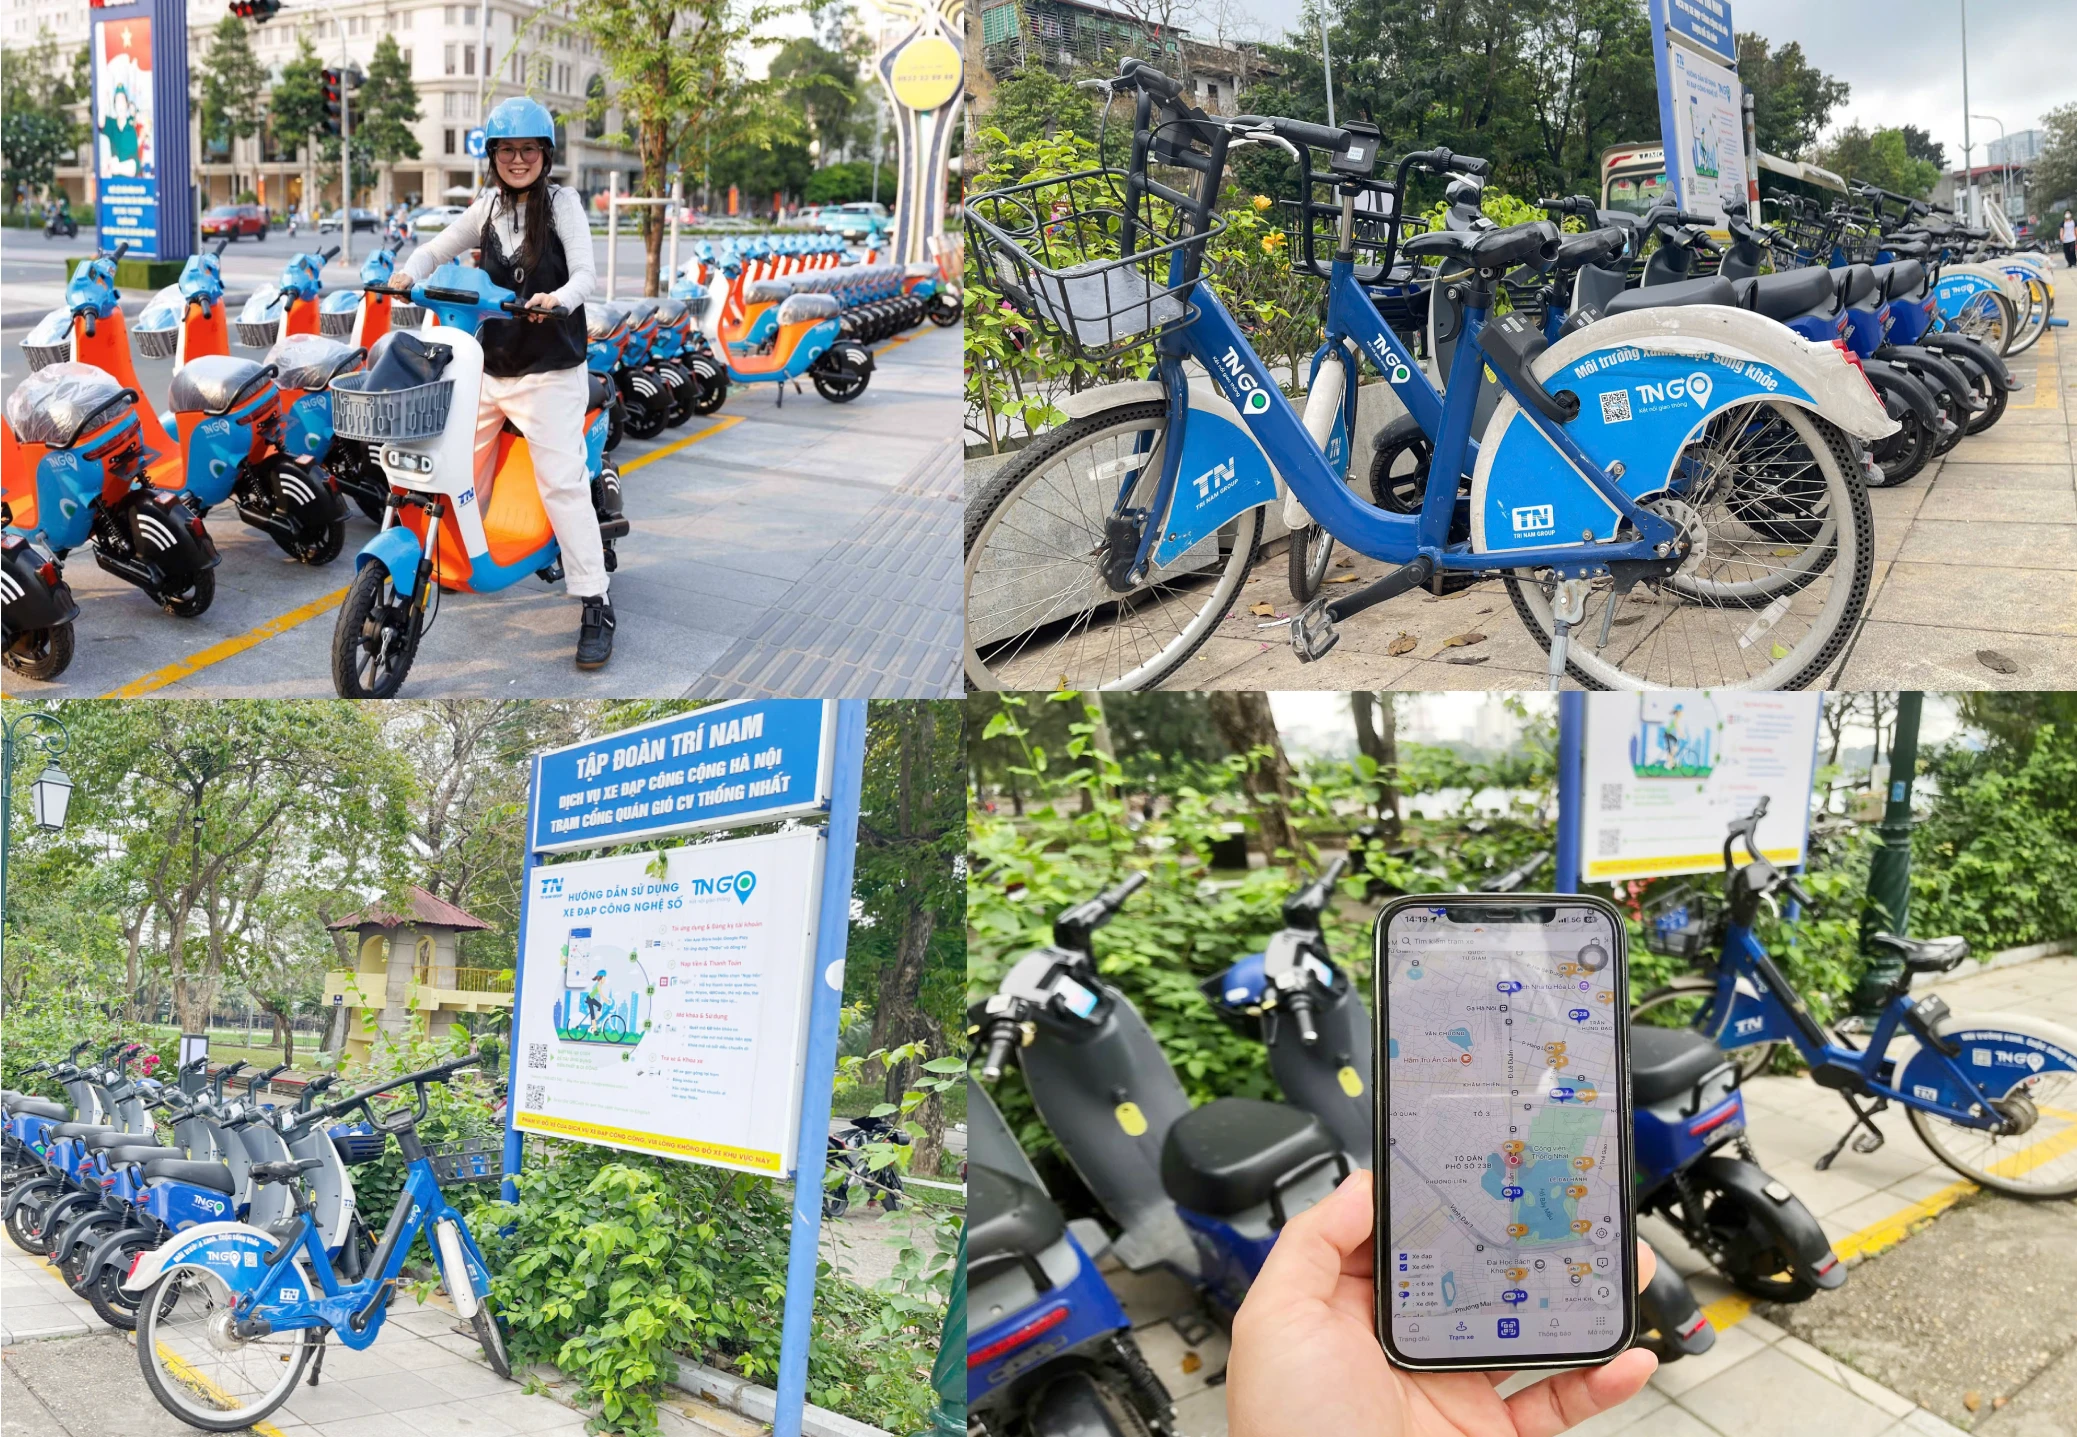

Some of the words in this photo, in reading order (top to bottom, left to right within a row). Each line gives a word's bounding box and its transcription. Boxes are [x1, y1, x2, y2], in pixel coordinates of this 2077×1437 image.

[1574, 360, 1599, 379] Môi
[1600, 347, 1641, 369] trường
[1745, 365, 1779, 392] khỏe
[1193, 456, 1234, 498] TN
[458, 487, 475, 505] TN
[1206, 491, 1219, 504] NAM
[1220, 478, 1238, 494] GROUP
[1517, 508, 1548, 527] TN
[577, 751, 609, 782] TẬP
[613, 737, 666, 772] ĐOÀN
[672, 722, 705, 757] TRÍ
[709, 712, 764, 749] NAM
[559, 791, 584, 811] DỊCH
[586, 787, 602, 805] VỤ
[603, 784, 618, 800] XE
[621, 778, 646, 799] ĐẠP
[648, 770, 684, 791] CÔNG
[687, 761, 726, 784] CỘNG
[729, 752, 750, 774] HÀ
[753, 746, 782, 771] NỘI
[551, 814, 579, 834] TRẠM
[582, 807, 613, 828] CỔNG
[615, 801, 649, 823] QUÁN
[652, 795, 674, 815] GIÓ
[676, 795, 694, 811] CV
[698, 782, 745, 807] THỐNG
[749, 771, 791, 799] NHẤT
[541, 877, 564, 894] TN
[568, 890, 603, 902] HƯỚNG
[606, 885, 627, 898] DẪN
[631, 883, 645, 896] SỬ
[649, 882, 679, 898] DỤNG
[563, 907, 574, 917] XE
[577, 906, 597, 918] ĐẠP
[599, 901, 631, 915] CÔNG
[634, 898, 664, 914] NGHỆ
[667, 895, 684, 909] SỐ
[1734, 1016, 1763, 1033] TN
[659, 1140, 675, 1148] LÒNG
[677, 1143, 699, 1152] KHÔNG
[723, 1151, 737, 1159] KHU
